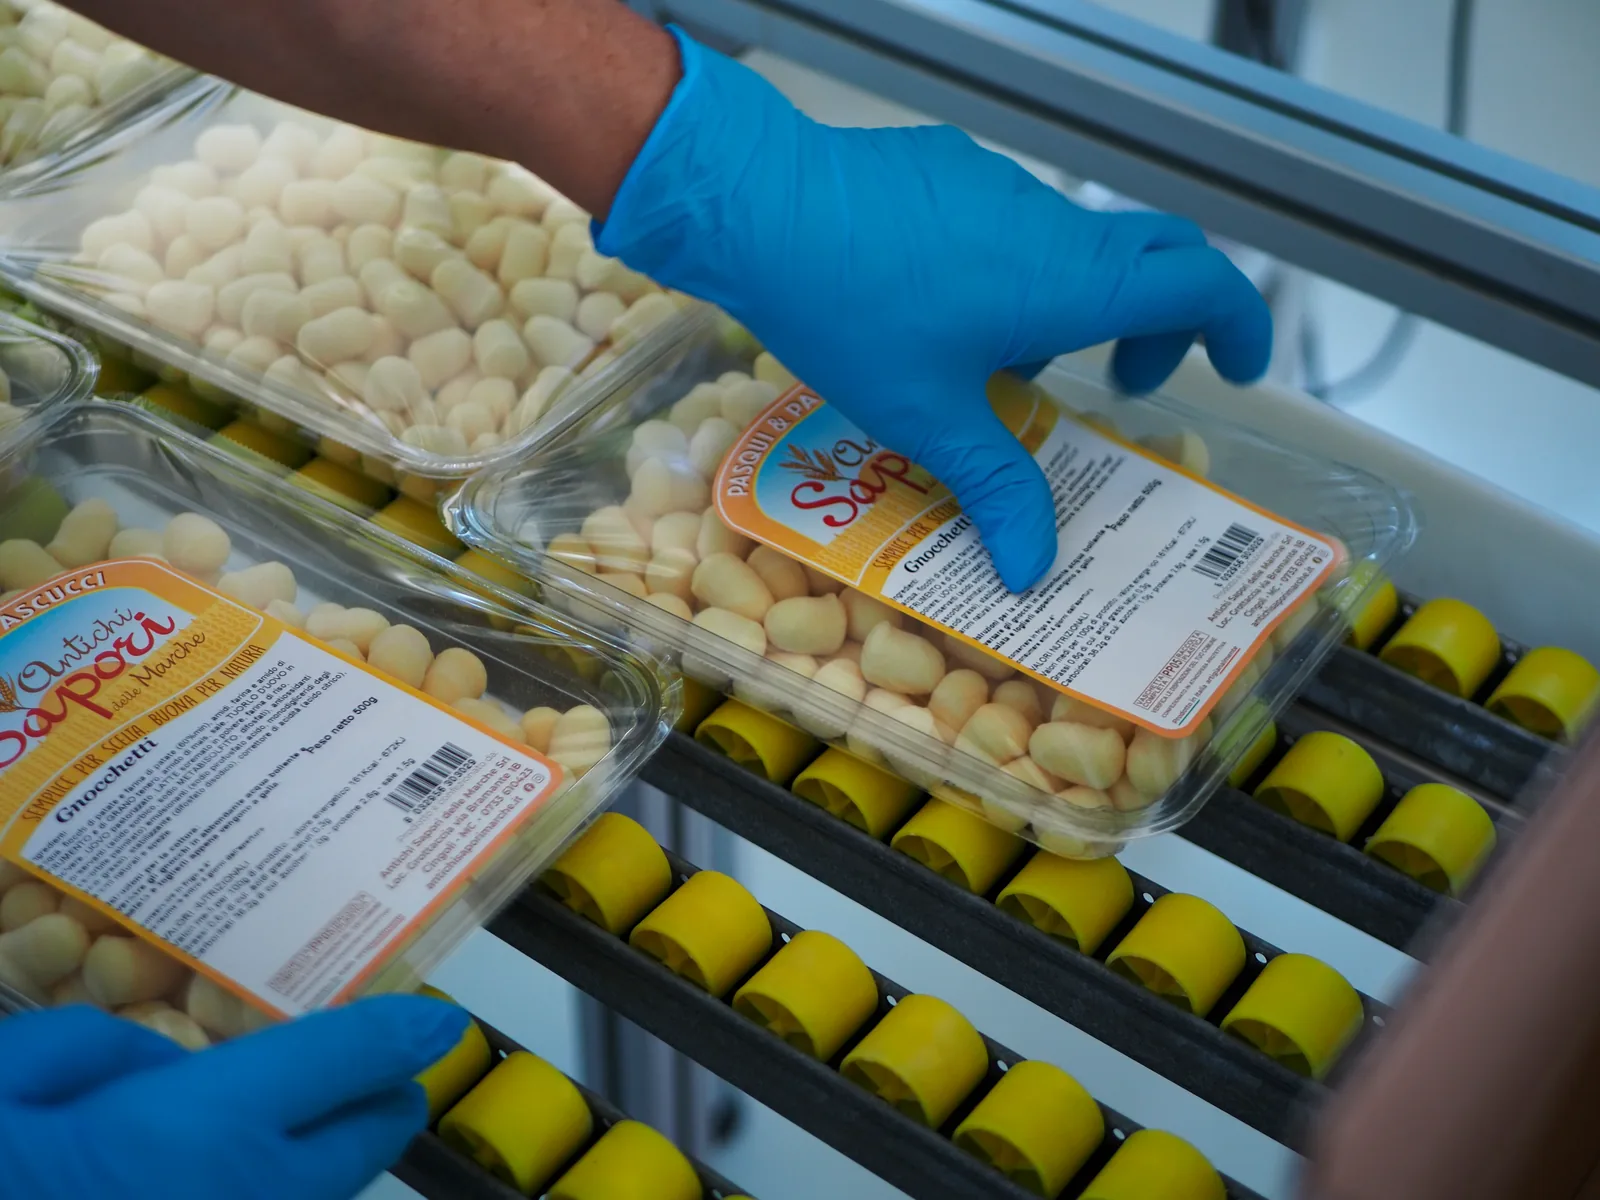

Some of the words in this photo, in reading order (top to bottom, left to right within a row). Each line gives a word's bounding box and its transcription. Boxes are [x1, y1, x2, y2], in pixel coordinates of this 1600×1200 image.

[727, 431, 775, 497] PASQUI
[768, 416, 791, 432] &
[791, 452, 928, 527] Sap
[873, 537, 914, 570] SEMPLICE
[906, 522, 932, 540] PER
[904, 516, 972, 573] Gnocchett
[1280, 566, 1298, 582] 0733
[0, 570, 106, 630] ASCUCCI
[907, 584, 941, 610] FRUMENTO
[949, 559, 971, 576] GRANO
[937, 583, 957, 598] UOVO
[1207, 600, 1231, 622] Antichi
[1227, 583, 1249, 601] Sapori
[1260, 544, 1285, 569] Marche
[1215, 616, 1233, 628] Loc.
[1265, 548, 1298, 580] Bramante
[998, 612, 1008, 621] per
[1028, 651, 1052, 671] VALORI
[1048, 612, 1089, 652] NUTRIZIONALI
[1068, 639, 1078, 649] per
[1076, 624, 1094, 638] 100g
[1175, 632, 1201, 657] RACCOLTA
[18, 608, 132, 692] Antichi
[112, 687, 141, 712] delle
[129, 632, 206, 687] Marche
[1161, 658, 1182, 676] PP05
[1180, 637, 1204, 660] PLASTICA
[270, 675, 311, 707] antiossidanti
[1135, 675, 1164, 704] VASCHETTA
[1141, 680, 1168, 707] COMPLETA
[1193, 684, 1207, 697] Italia
[23, 776, 77, 823] SEMPLICE
[74, 753, 104, 776] PER
[148, 694, 198, 726] BUONA
[196, 677, 224, 698] PER
[221, 644, 267, 679] NATURA
[94, 799, 118, 820] patate
[123, 776, 145, 793] farina
[153, 750, 176, 769] patate
[230, 688, 251, 704] farina
[256, 666, 277, 683] amido
[106, 795, 135, 821] GRANO
[161, 756, 183, 774] amido
[225, 693, 258, 718] TUORLO
[256, 670, 287, 694] D'UOVO
[144, 789, 188, 826] emulsionanti
[187, 770, 210, 789] (sodio
[266, 684, 315, 723] monodigliceridi
[313, 671, 330, 684] degli
[171, 787, 205, 816] (difosfato
[238, 732, 271, 759] correttore
[278, 707, 301, 726] acidità
[299, 690, 322, 707] (acido
[304, 734, 331, 754] Peso
[330, 714, 354, 734] netto
[352, 696, 378, 714] 500g
[56, 736, 158, 824] Gnocchetti
[84, 831, 110, 853] UOVO
[153, 771, 180, 792] LATTE
[179, 744, 212, 771] scremato
[244, 700, 266, 715] farina
[348, 760, 378, 784] 161Kcal
[381, 736, 406, 757] 672KJ
[412, 785, 445, 814] 032956
[443, 758, 476, 786] 303029
[199, 798, 244, 837] abbondante
[245, 778, 269, 798] acqua
[267, 752, 299, 777] bollente
[379, 845, 414, 879] Antichi
[411, 818, 443, 847] Sapori
[441, 798, 465, 819] delle
[462, 768, 497, 798] Marche
[495, 756, 510, 768] Srl
[421, 841, 456, 873] Cingoli
[458, 821, 476, 837] MC
[480, 794, 504, 815] 0733
[501, 767, 533, 795] 610423
[452, 813, 469, 825] via
[465, 772, 511, 812] Bramante
[507, 762, 521, 772] 1B
[189, 834, 218, 859] appena
[218, 805, 251, 832] vengono
